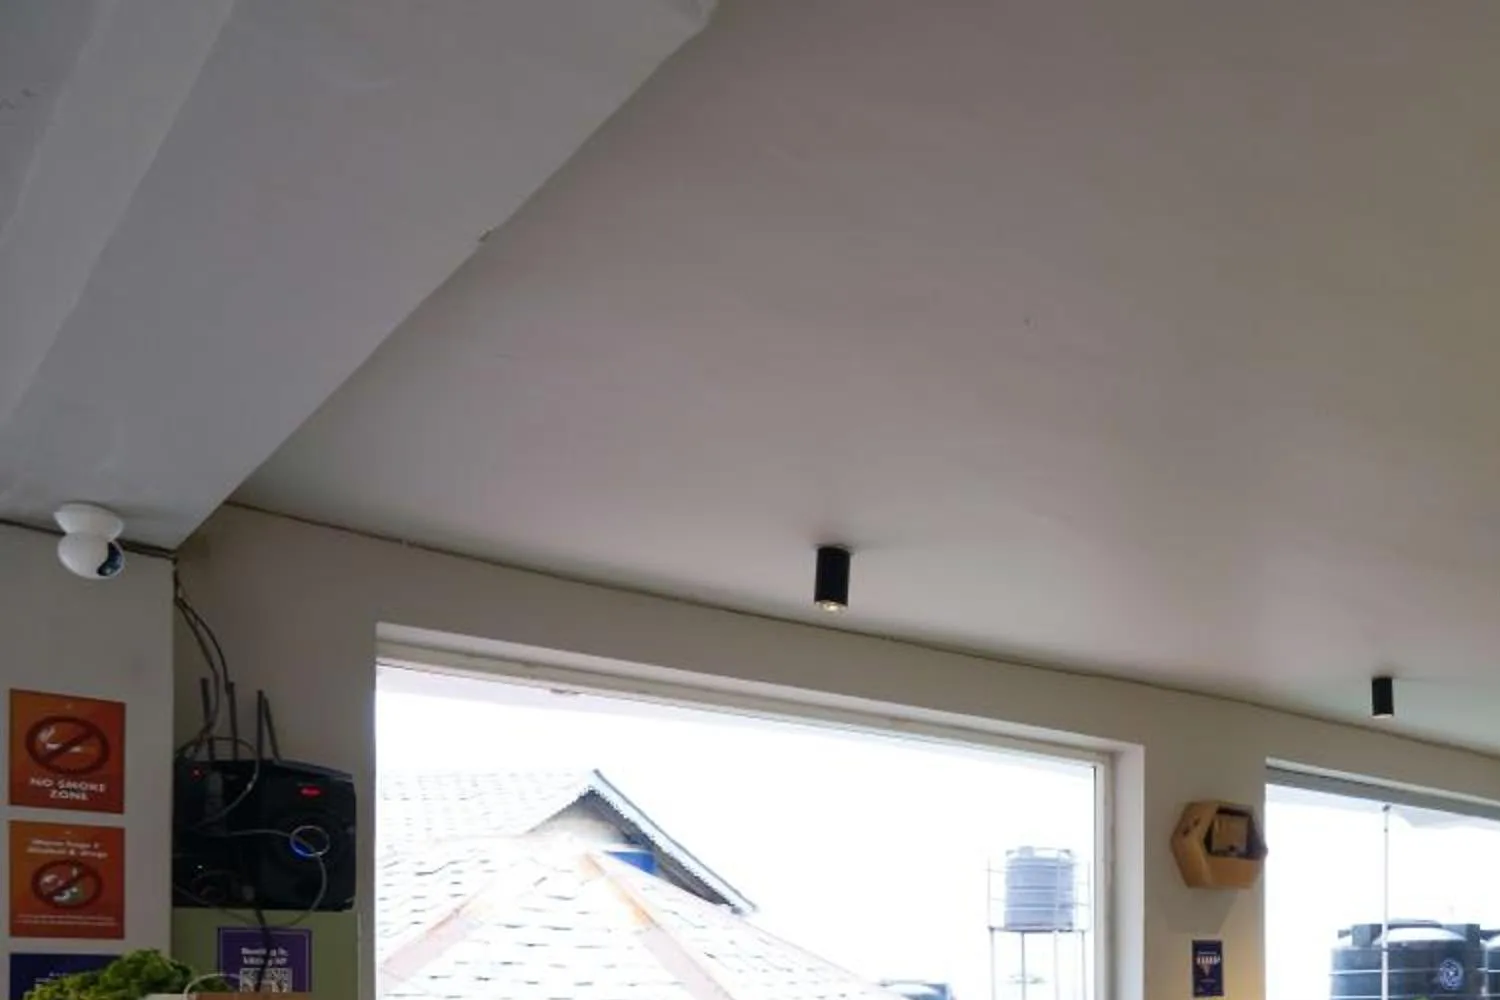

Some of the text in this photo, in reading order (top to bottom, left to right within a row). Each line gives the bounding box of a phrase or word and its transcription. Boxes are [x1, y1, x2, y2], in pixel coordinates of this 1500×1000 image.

[29, 777, 107, 793] NO SMOKE
[49, 789, 89, 801] ZONE
